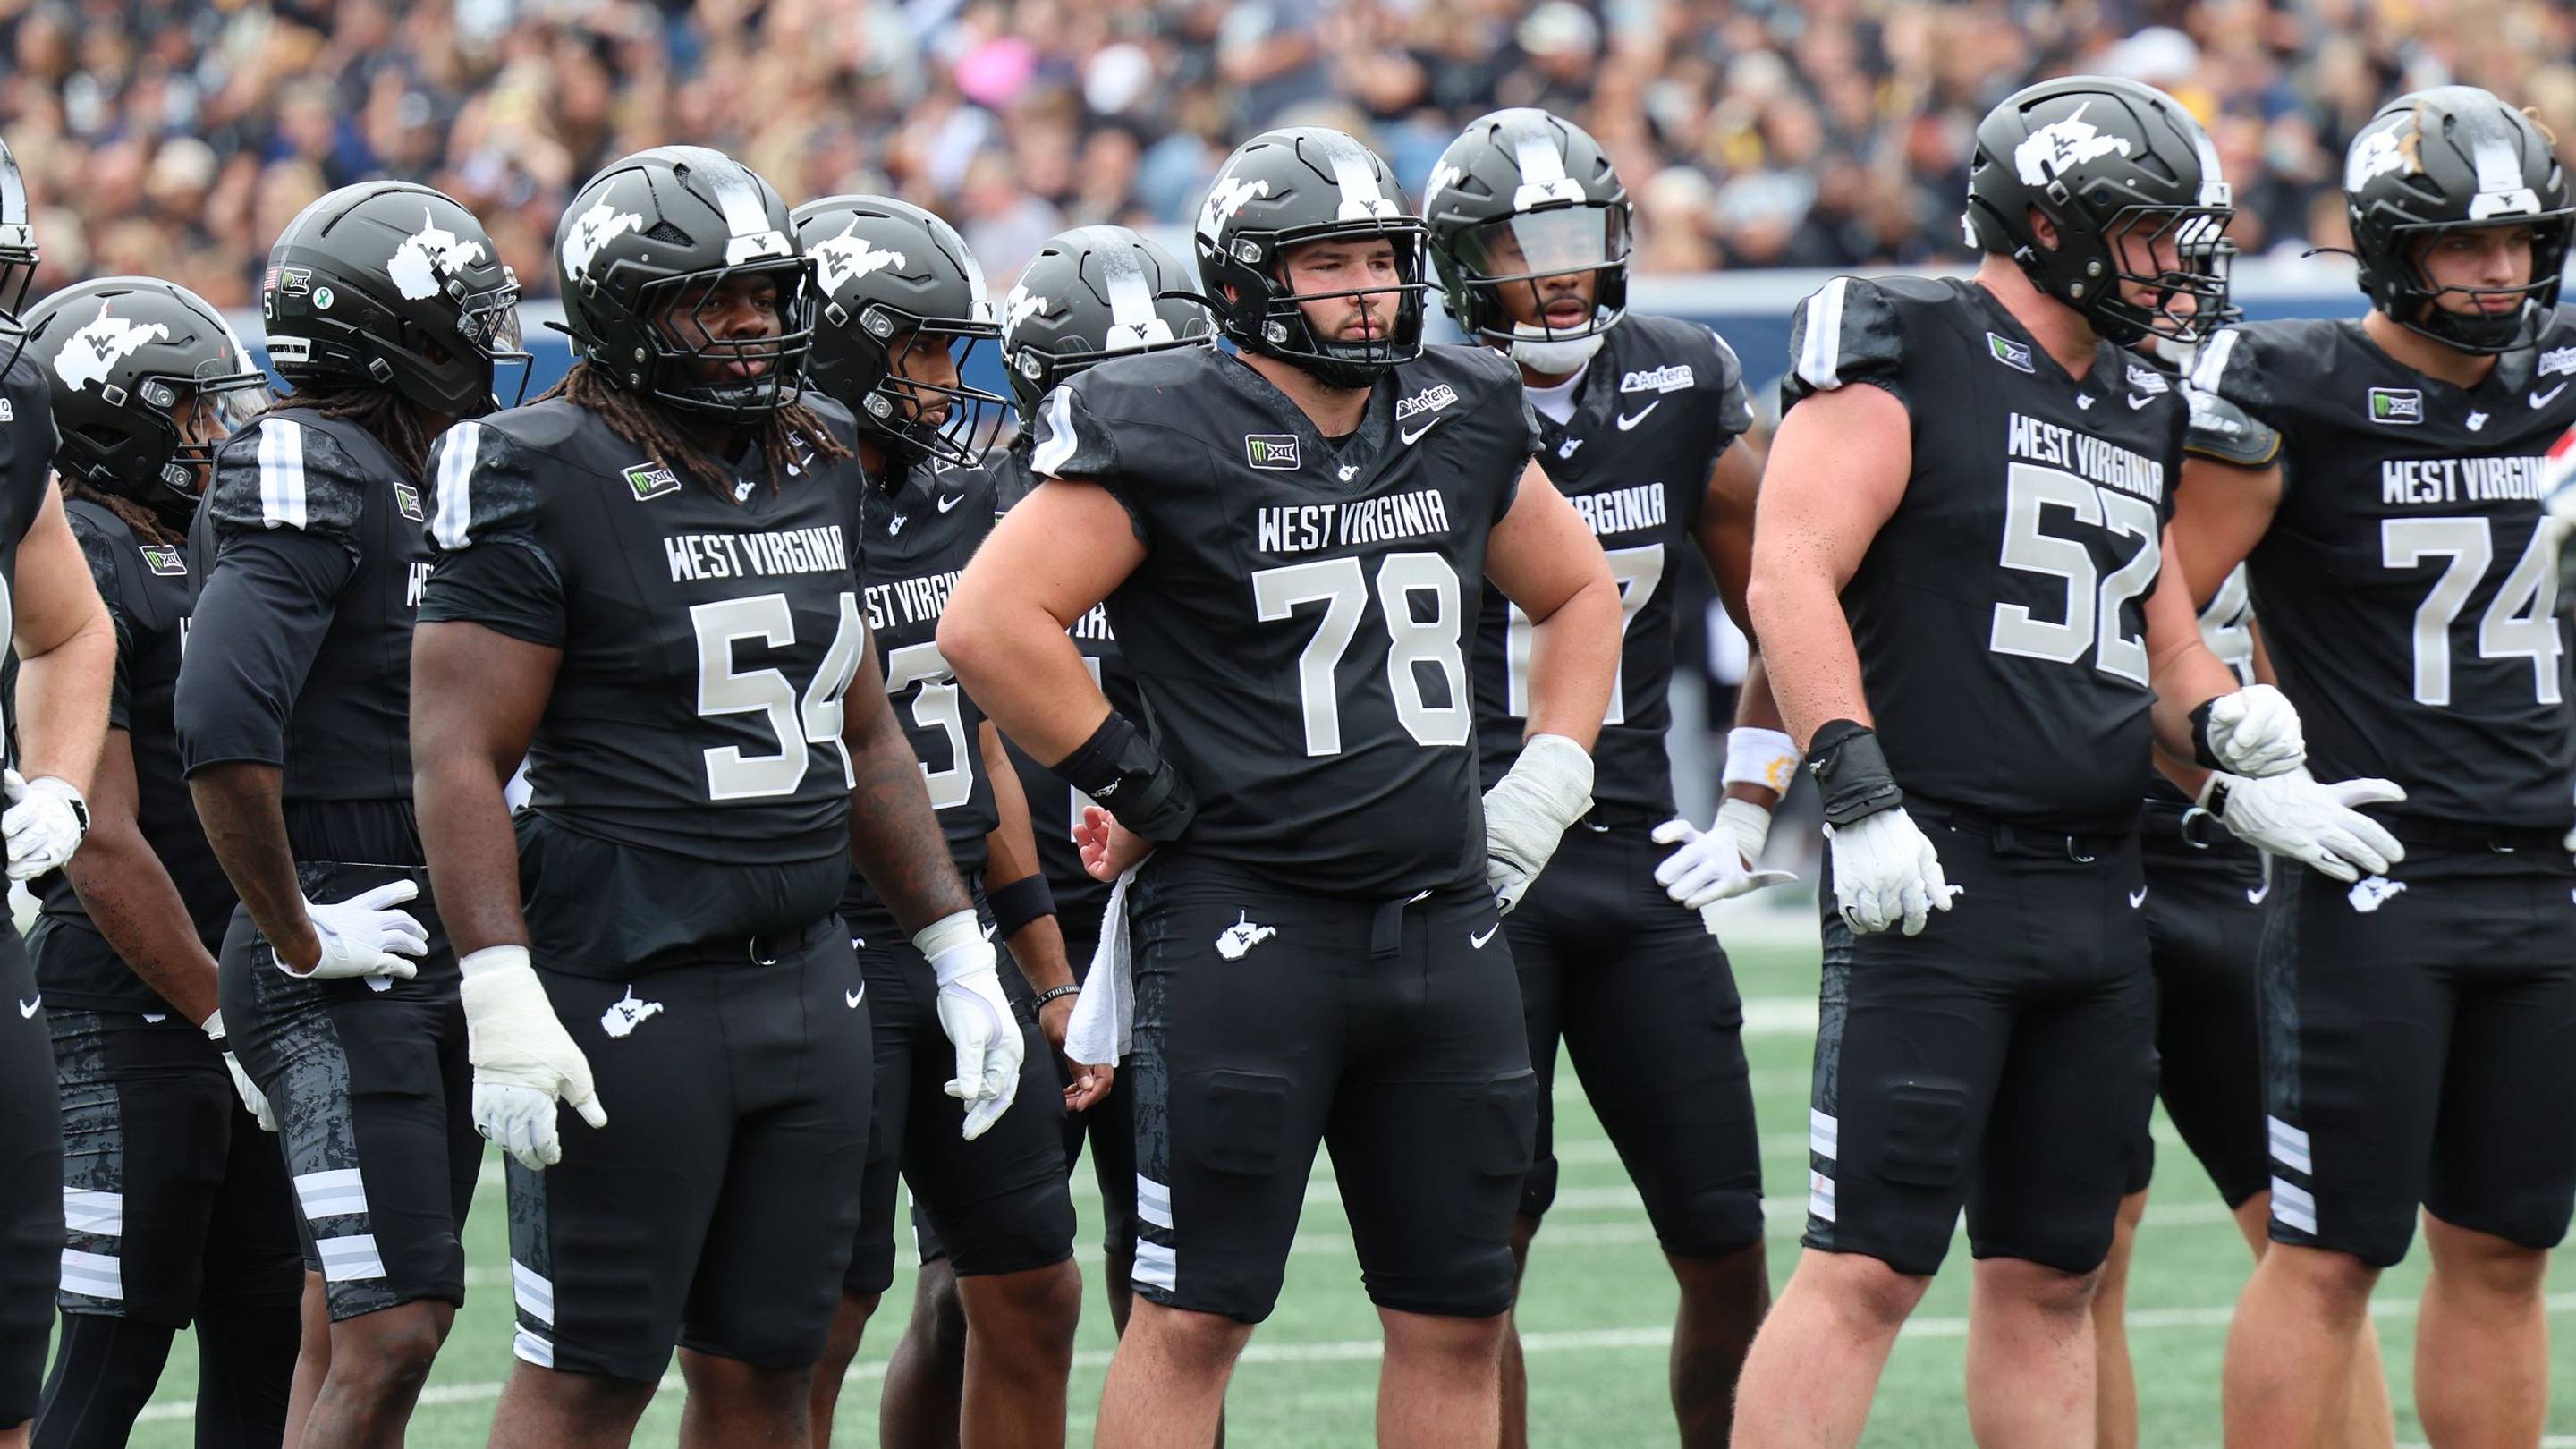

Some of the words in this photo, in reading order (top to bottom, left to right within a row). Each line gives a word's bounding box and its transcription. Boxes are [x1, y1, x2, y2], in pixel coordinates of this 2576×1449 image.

[1411, 385, 1452, 412] Antero
[2009, 412, 2073, 469] WEST
[2076, 433, 2165, 504] VIRGINIA
[2382, 458, 2458, 504] WEST
[2461, 456, 2545, 501] VIRGIN
[1258, 504, 1337, 552] WEST
[1340, 489, 1451, 547] VIRGINIA
[1566, 482, 1667, 537] RGINIA
[664, 534, 744, 582] WEST
[739, 525, 847, 576] VIRGINIA
[1989, 462, 2162, 688] 52
[864, 583, 896, 631] ST
[2381, 514, 2564, 706] 74
[1251, 551, 1472, 758] 78
[689, 591, 865, 801] 54
